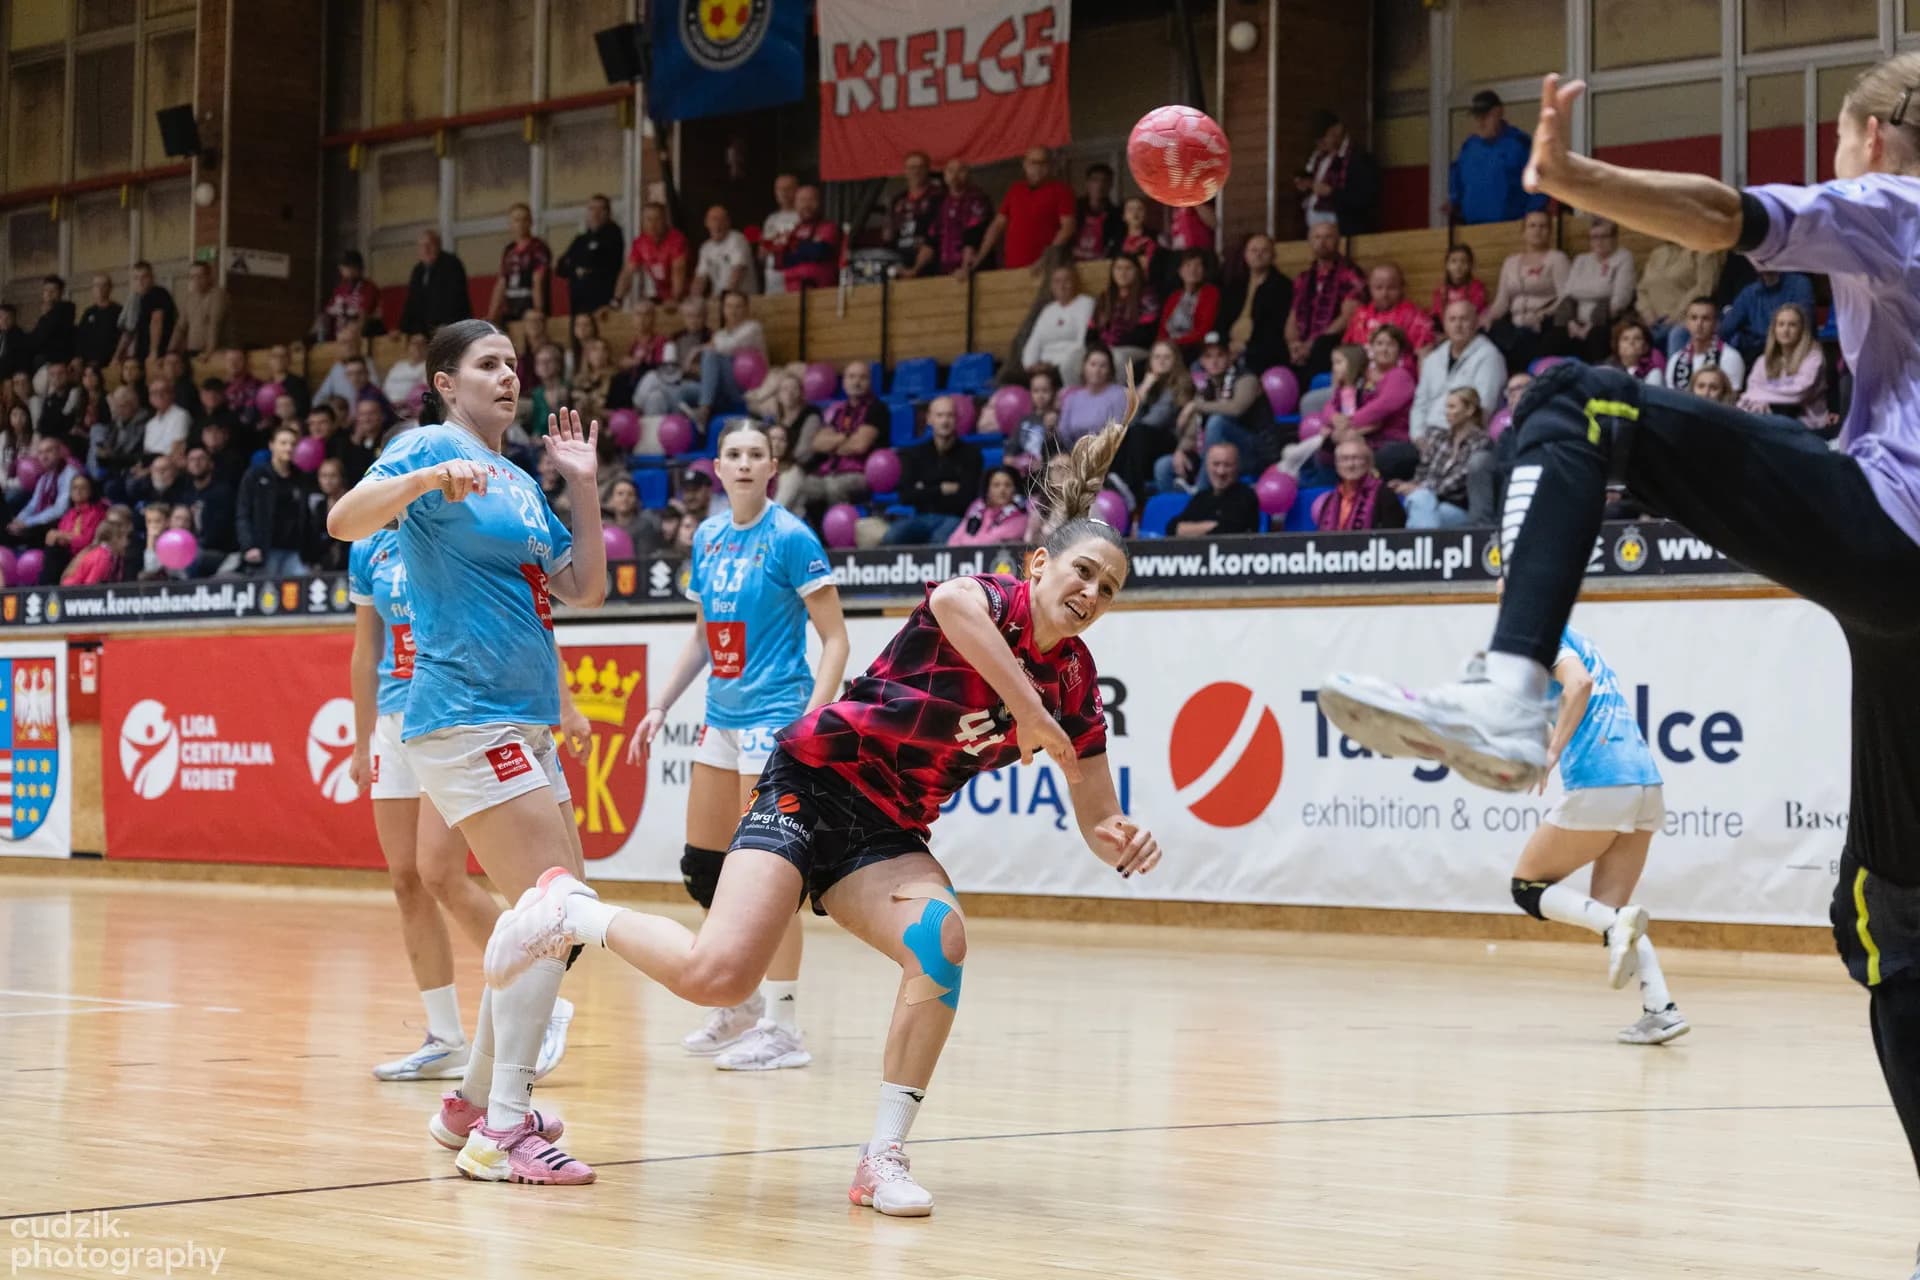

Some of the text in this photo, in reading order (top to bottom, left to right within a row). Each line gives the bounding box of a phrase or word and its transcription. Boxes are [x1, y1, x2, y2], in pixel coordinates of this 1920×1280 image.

[832, 6, 1055, 117] KIELCE
[527, 535, 551, 559] flex
[1133, 535, 1473, 579] www.koronahandball.pl
[712, 558, 749, 592] 53
[835, 552, 984, 586] ahandball.pl
[64, 583, 255, 617] www.koronahandball.pl
[181, 713, 217, 738] LIGA
[954, 709, 1006, 756] 41
[1636, 684, 1743, 763] lce
[181, 741, 275, 766] CENTRALNA
[497, 757, 523, 770] Energa
[181, 767, 237, 791] KOBIET
[778, 815, 811, 841] Kielce
[1302, 797, 1440, 829] exhibition
[1450, 798, 1470, 831] &
[1662, 806, 1743, 838] entre
